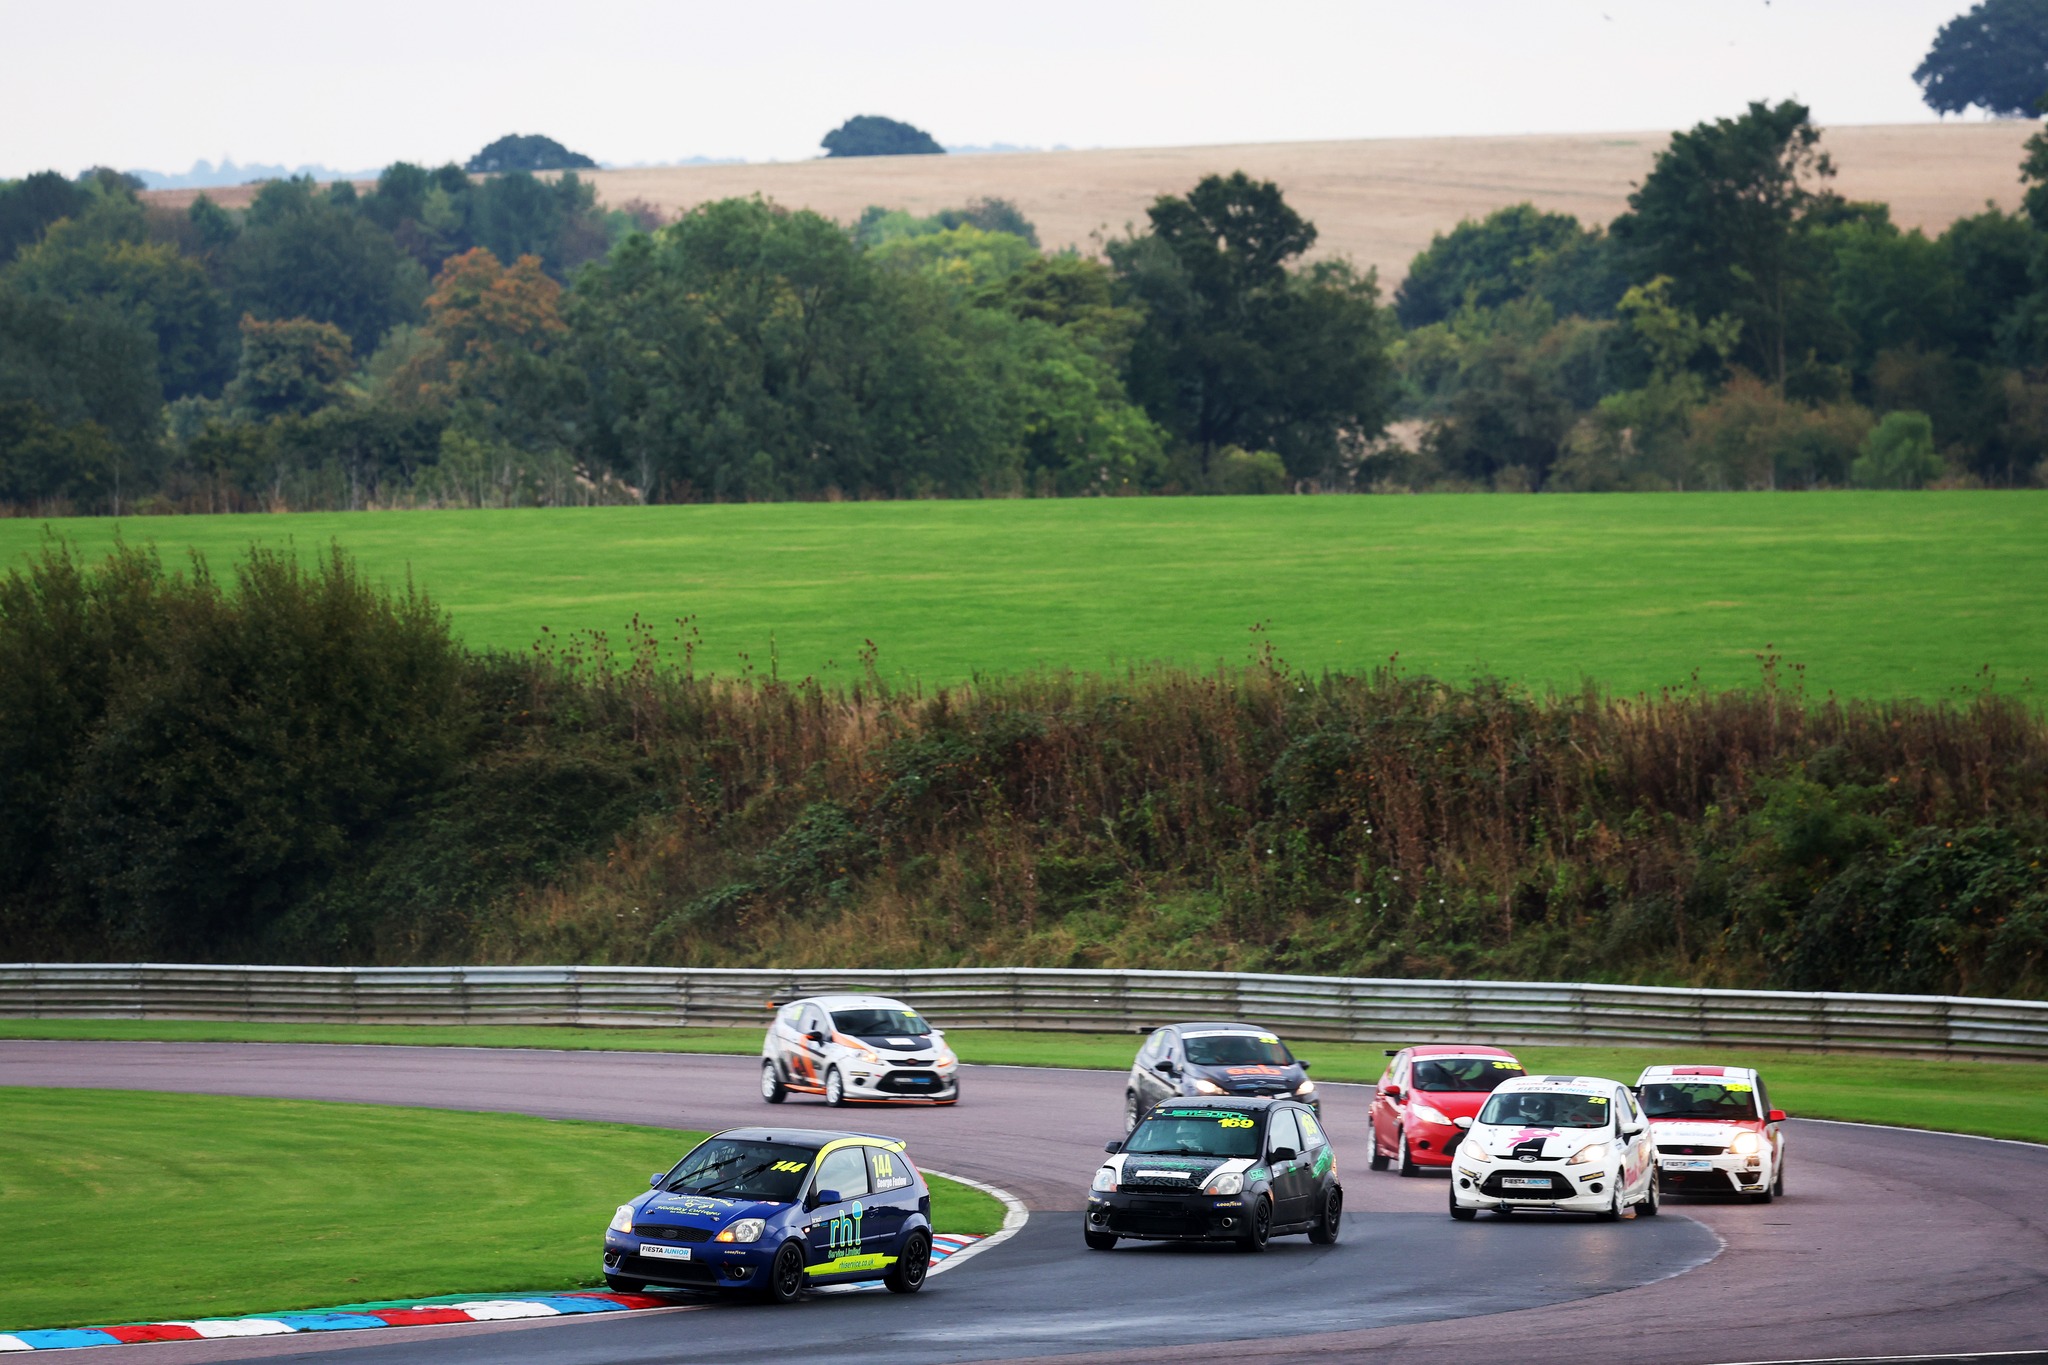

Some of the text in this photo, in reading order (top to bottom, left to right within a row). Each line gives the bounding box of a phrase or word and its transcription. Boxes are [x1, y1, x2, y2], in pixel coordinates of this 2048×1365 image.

[1226, 1064, 1282, 1076] eab
[1217, 1118, 1254, 1128] 169
[770, 1160, 808, 1173] 144
[872, 1154, 893, 1178] 144
[641, 1245, 664, 1254] FIESTA
[664, 1248, 690, 1256] JUNIOR
